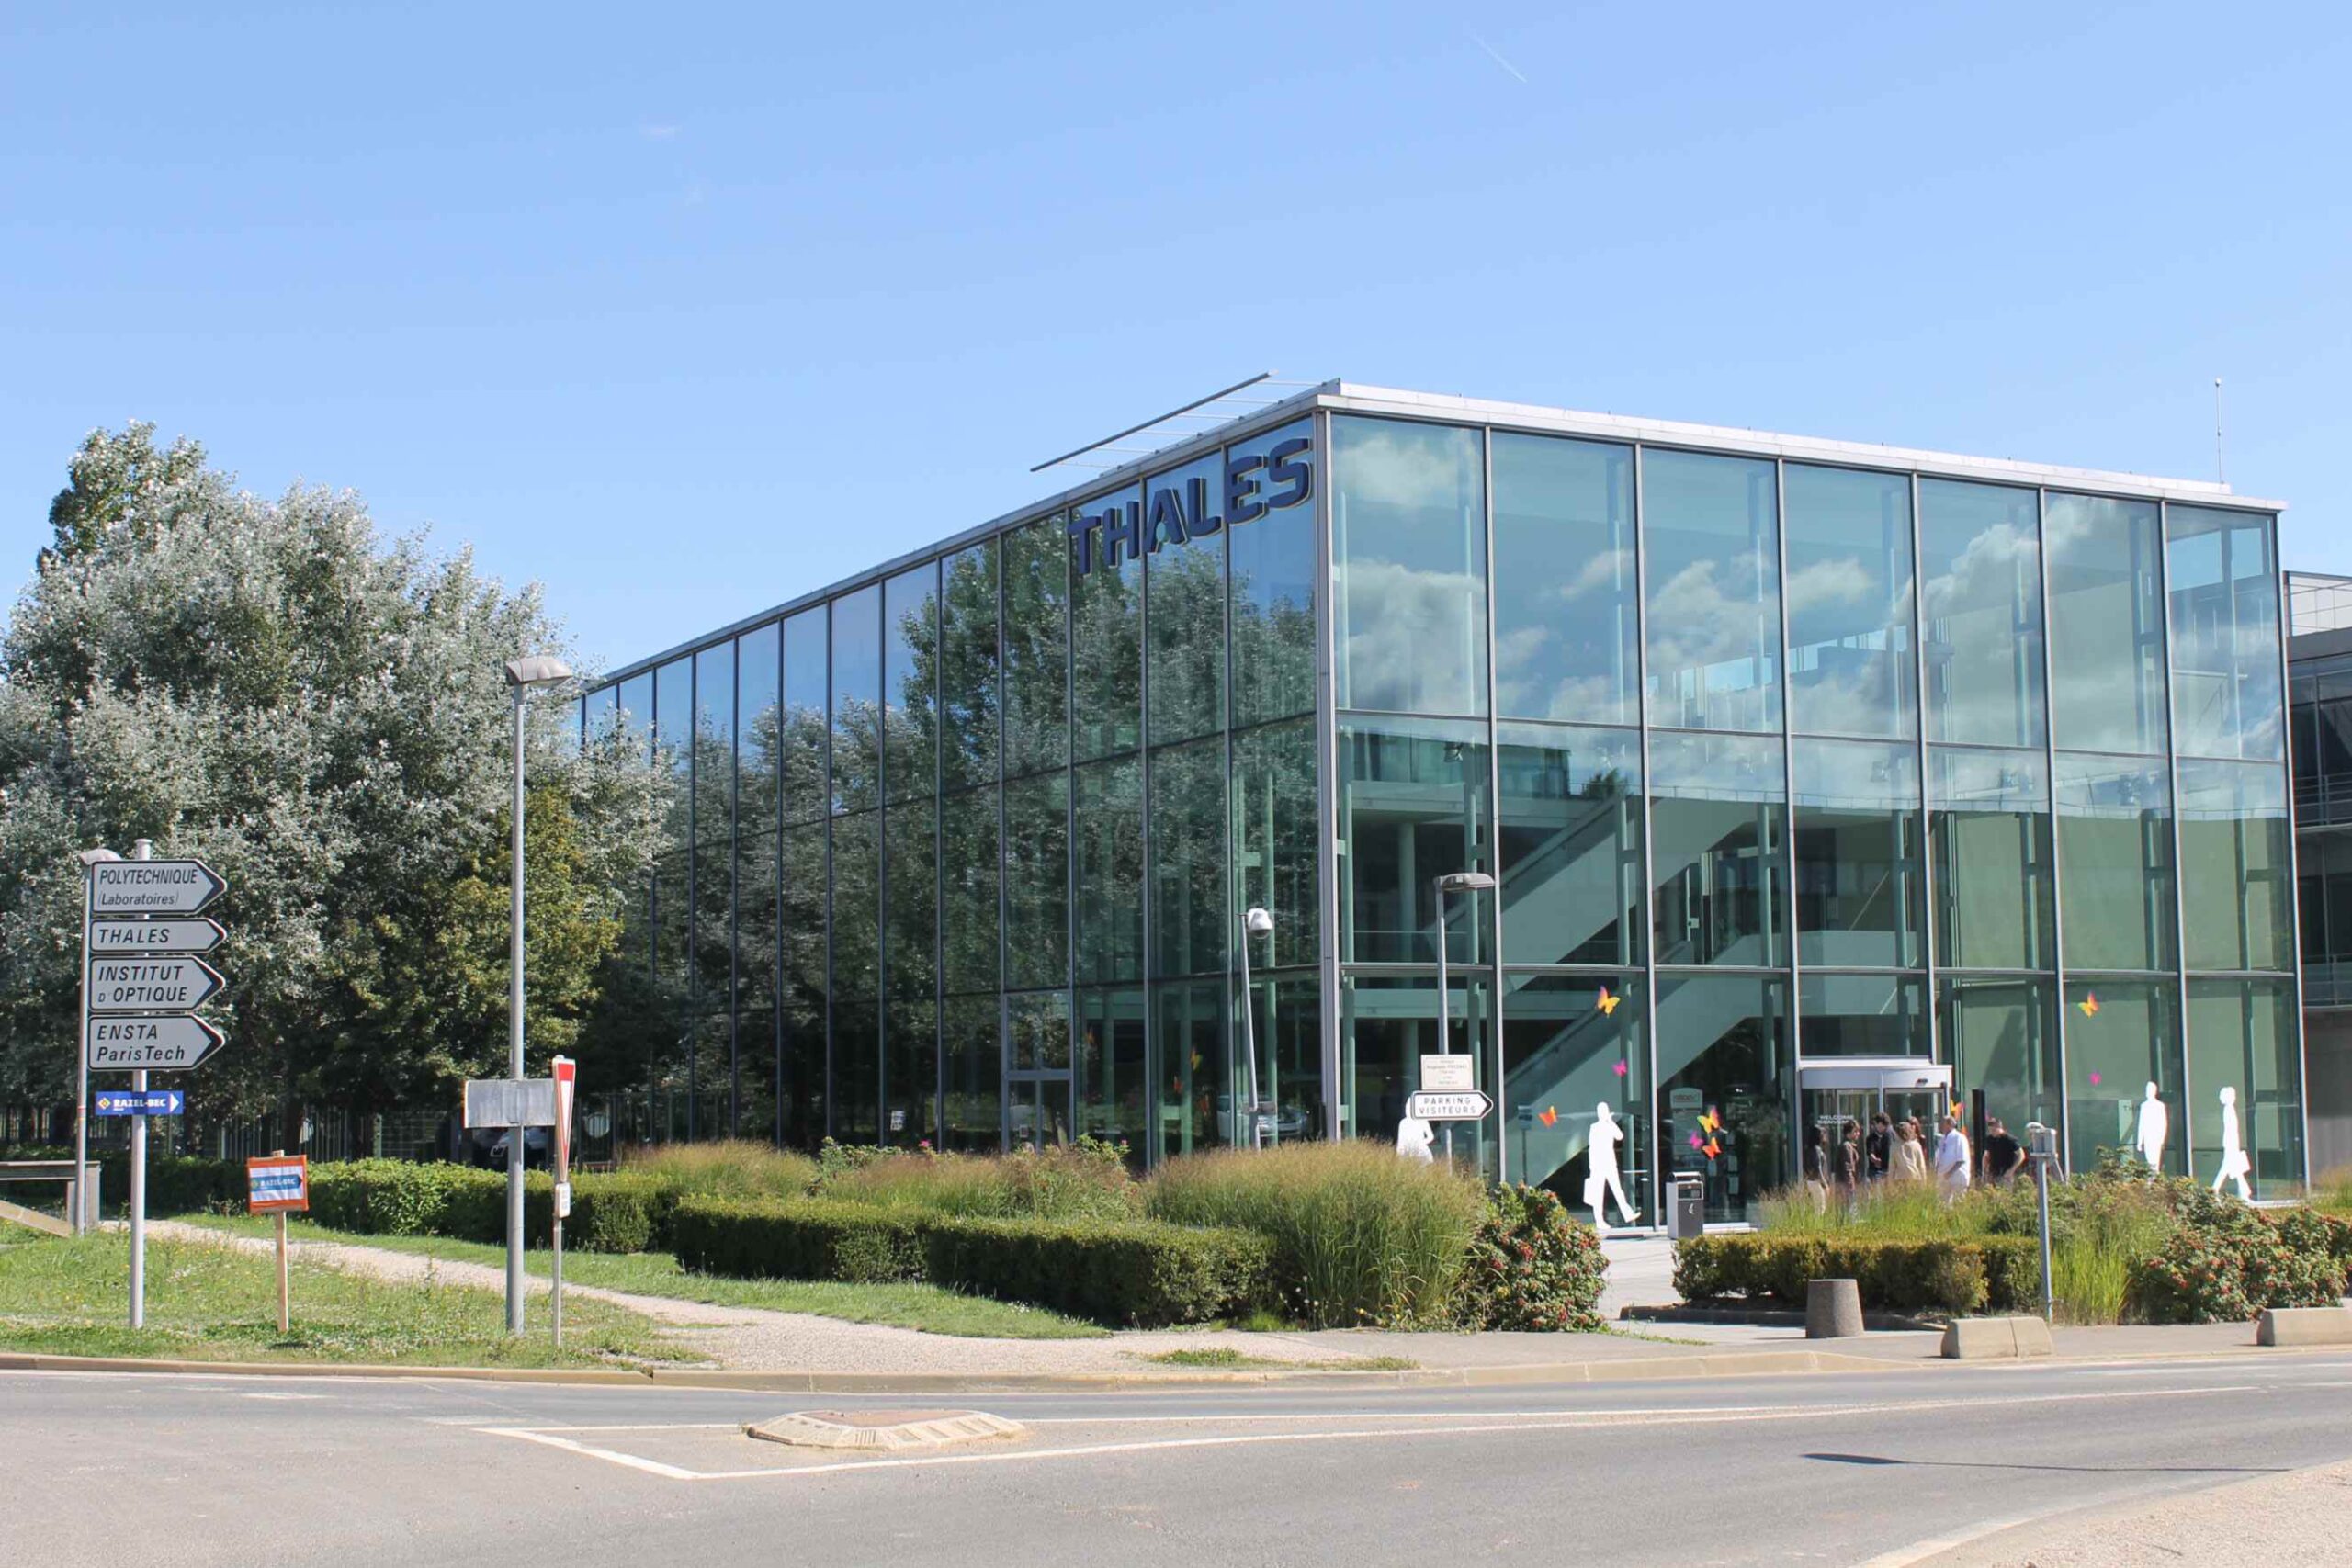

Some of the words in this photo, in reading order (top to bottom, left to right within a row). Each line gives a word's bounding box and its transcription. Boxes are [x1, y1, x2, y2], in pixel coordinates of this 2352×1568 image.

[1067, 437, 1314, 576] THALES
[99, 869, 198, 885] POLYTECHNIQUE
[97, 890, 179, 907] (Laboratoires)
[98, 929, 170, 943] THALES
[98, 965, 183, 981] INSTITUT
[97, 1024, 157, 1040] ENSTA
[1424, 1097, 1471, 1105] PARKING
[1419, 1106, 1476, 1114] VISITEURS
